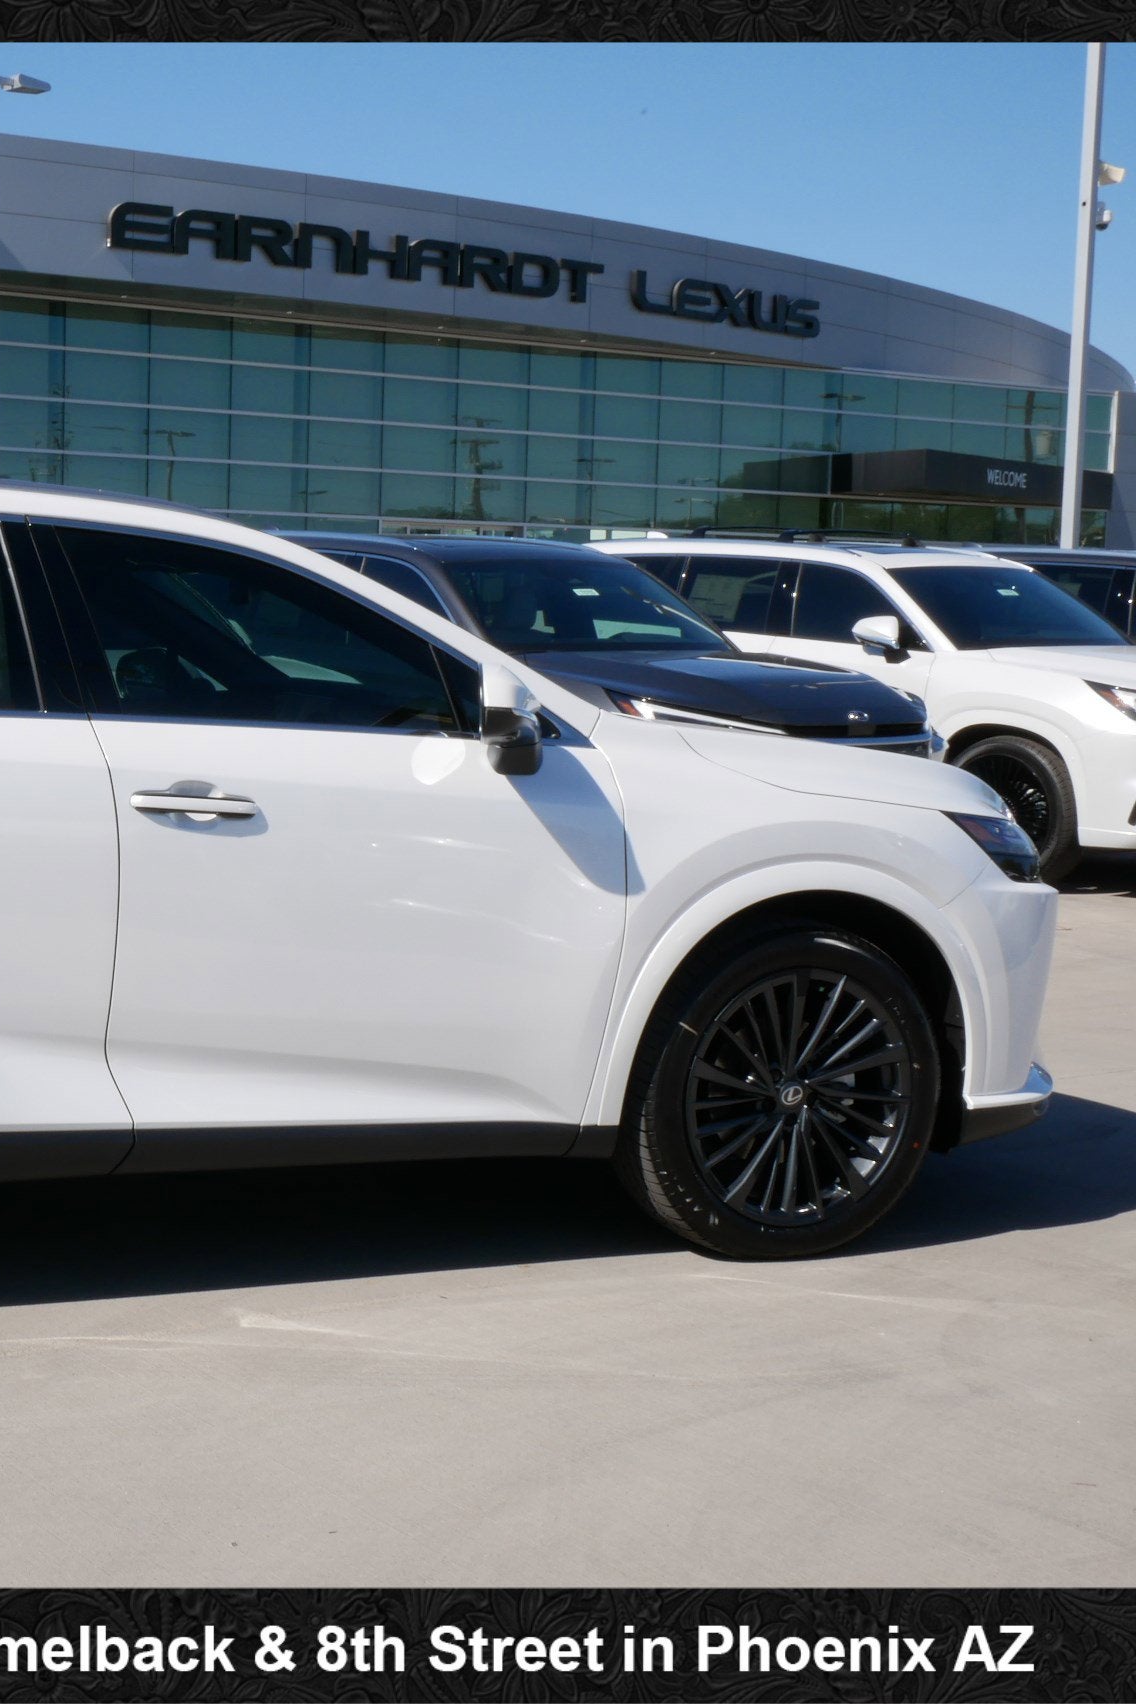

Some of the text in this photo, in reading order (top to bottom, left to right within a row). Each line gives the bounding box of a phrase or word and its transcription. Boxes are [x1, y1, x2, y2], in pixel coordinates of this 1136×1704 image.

[108, 202, 821, 338] EARNHARDT LEXUS
[987, 468, 1027, 488] WELCOME
